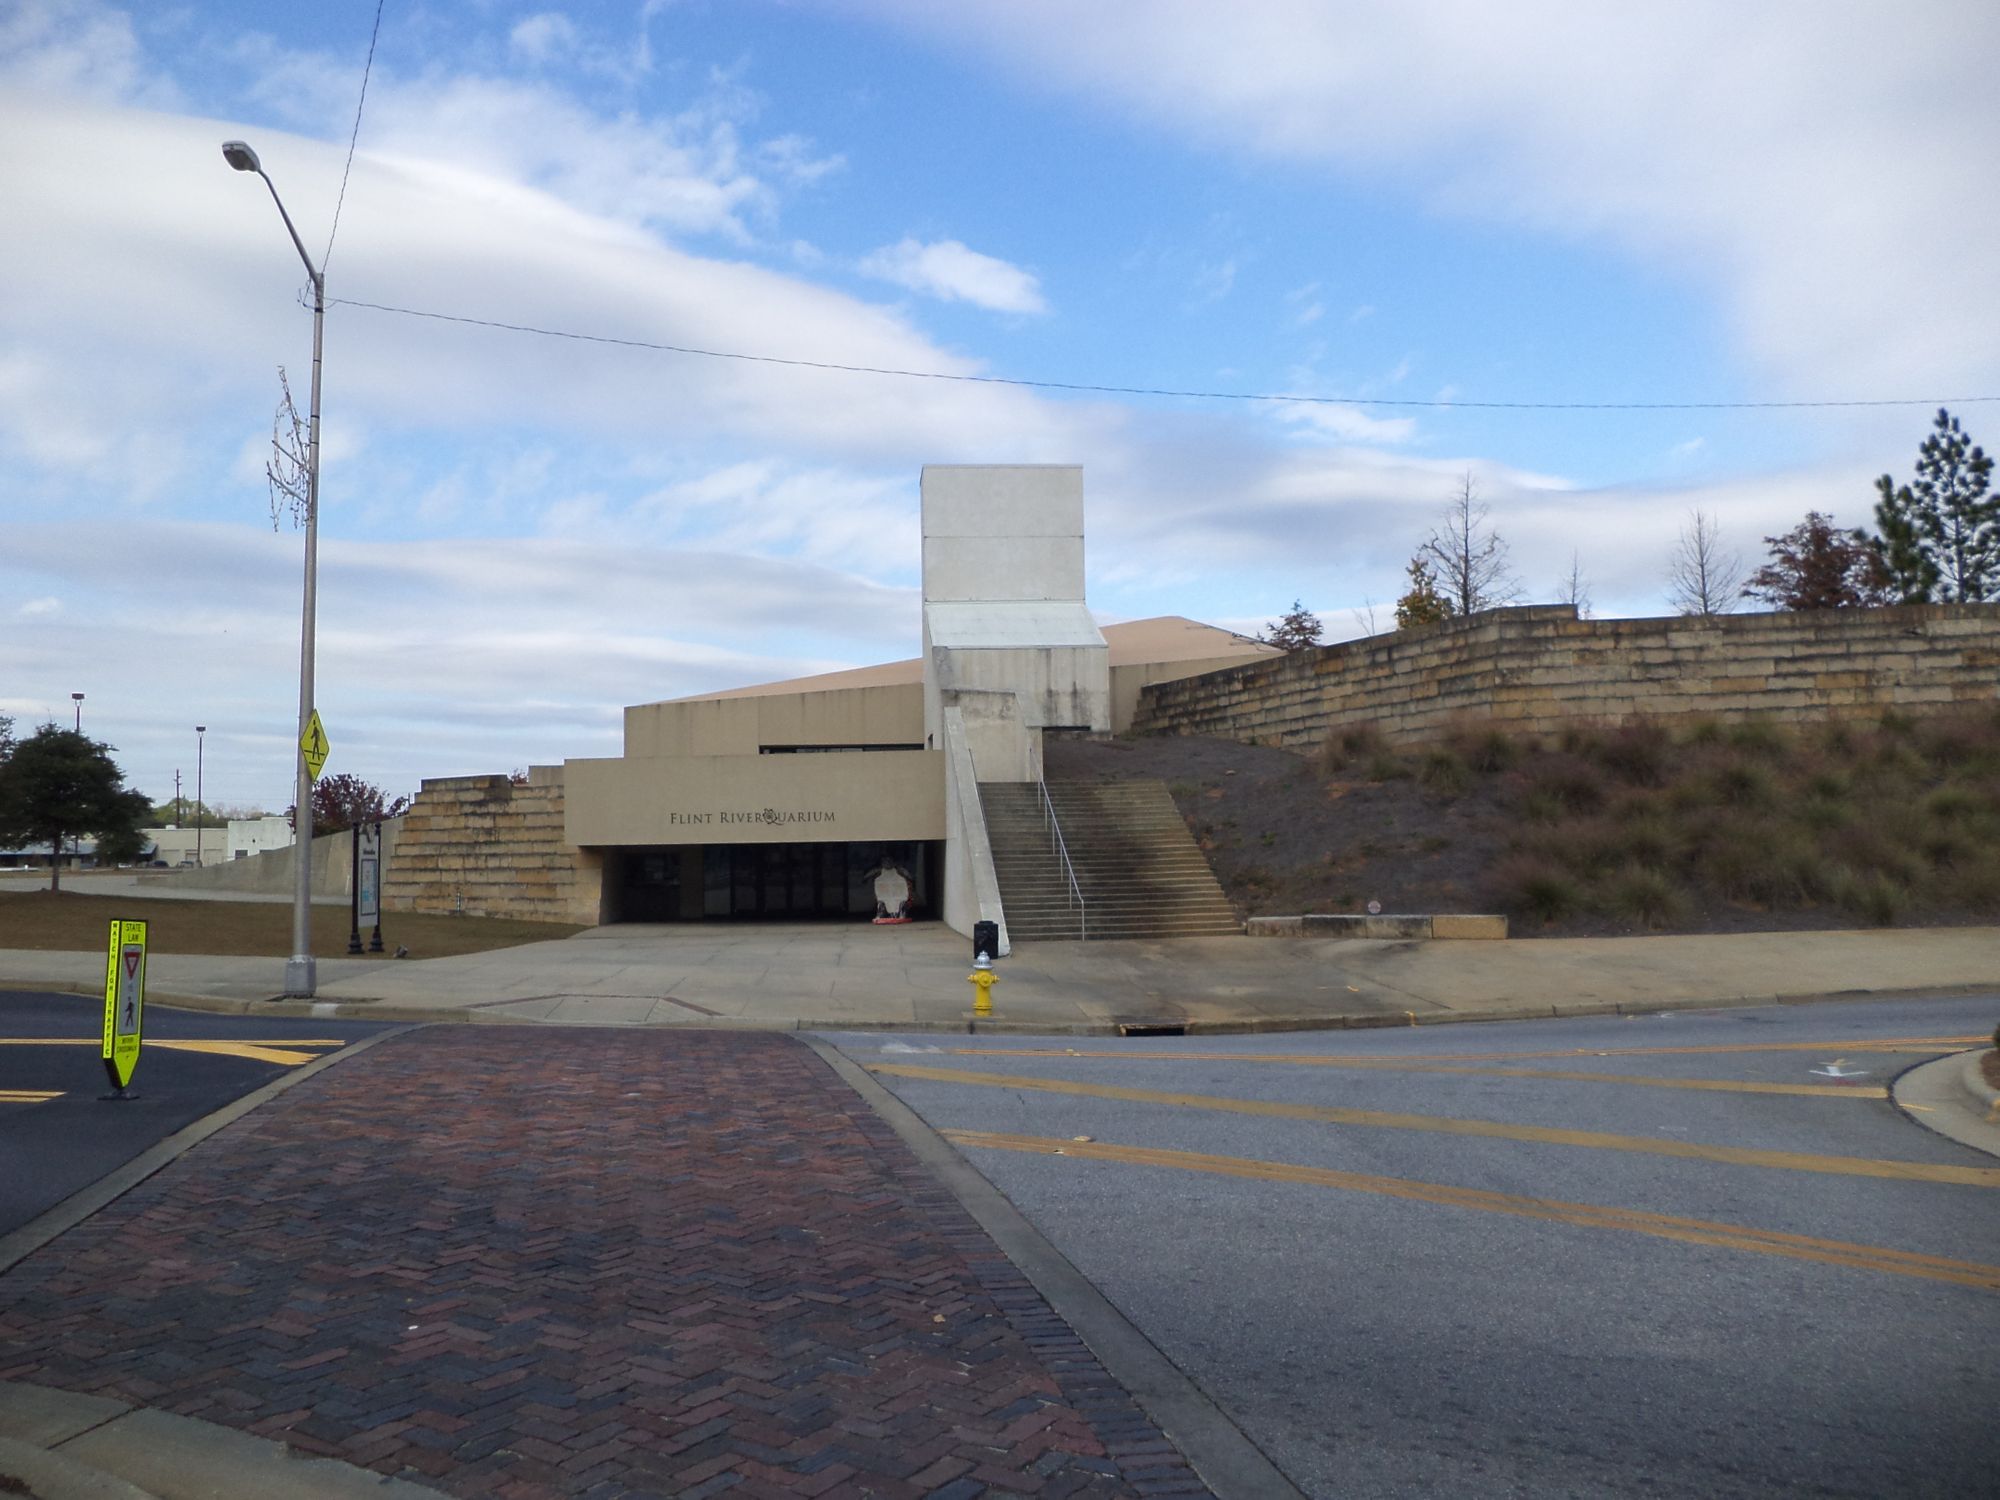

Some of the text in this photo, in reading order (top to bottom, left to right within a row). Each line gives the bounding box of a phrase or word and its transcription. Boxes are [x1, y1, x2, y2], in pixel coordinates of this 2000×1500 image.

[670, 808, 836, 826] FLINT RIVERQUARIUM
[125, 923, 142, 932] STATE
[128, 933, 140, 942] LAW
